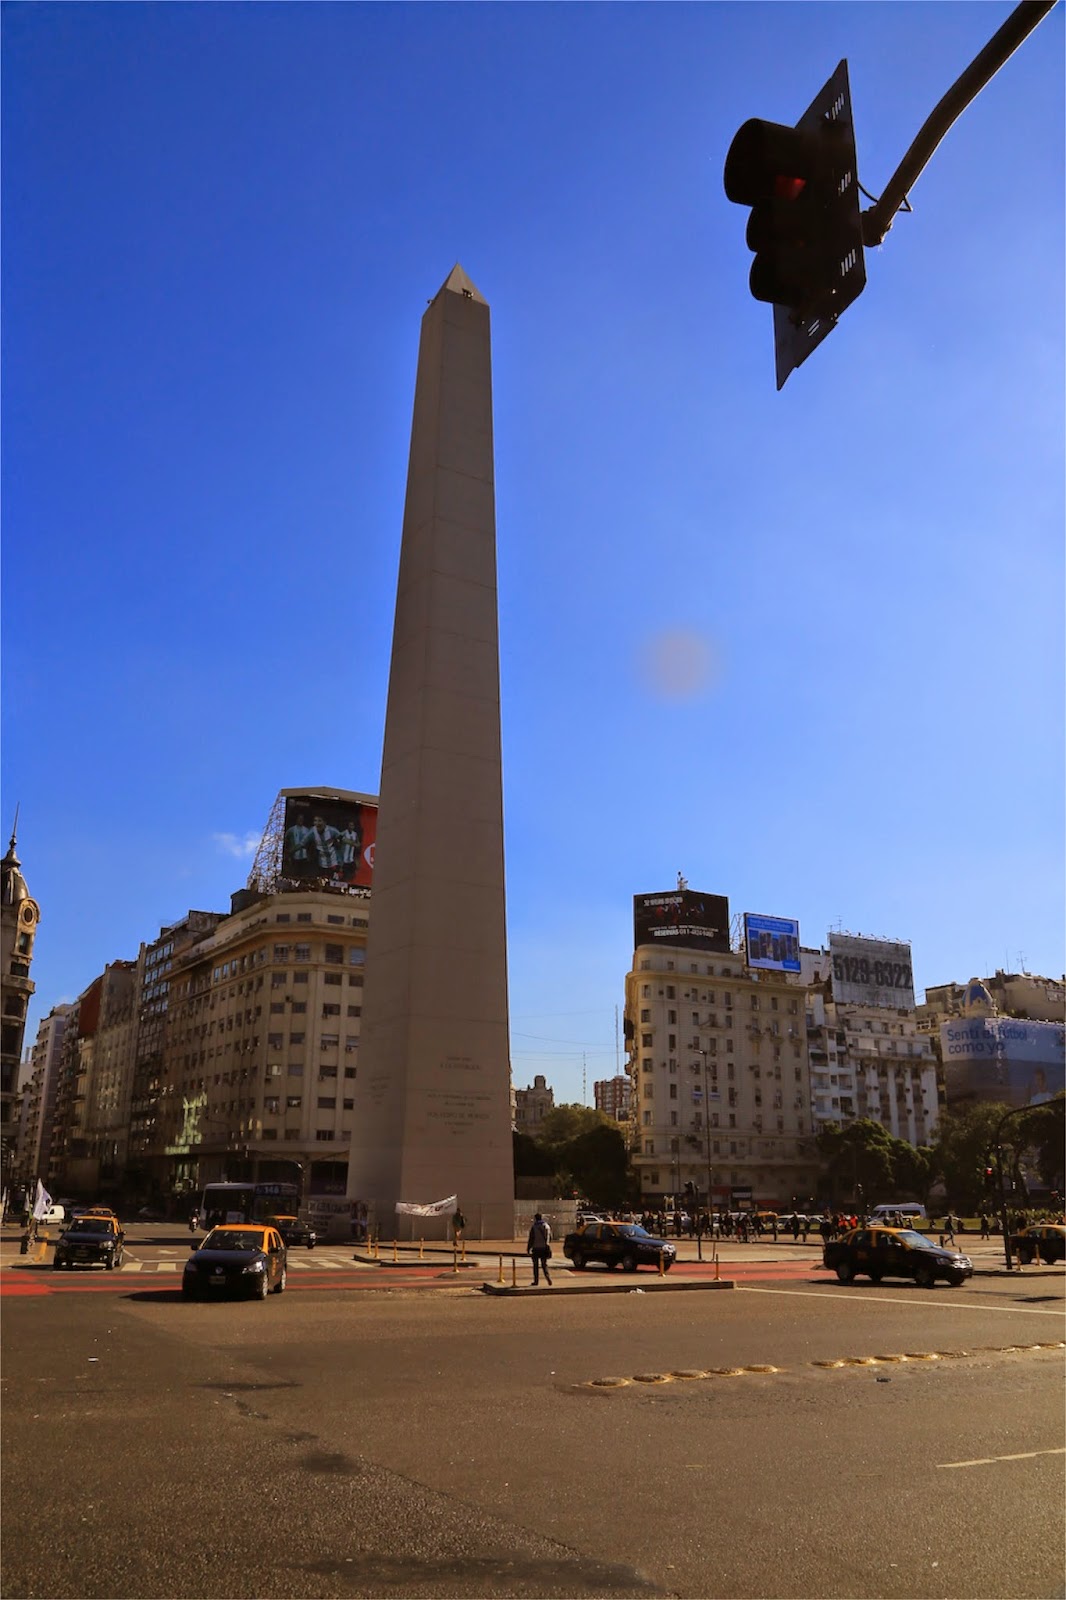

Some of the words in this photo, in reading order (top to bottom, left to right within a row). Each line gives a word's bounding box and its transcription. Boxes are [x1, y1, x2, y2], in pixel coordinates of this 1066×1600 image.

[833, 954, 913, 990] 5129-6322
[948, 1042, 985, 1055] como
[987, 1042, 1005, 1055] yo
